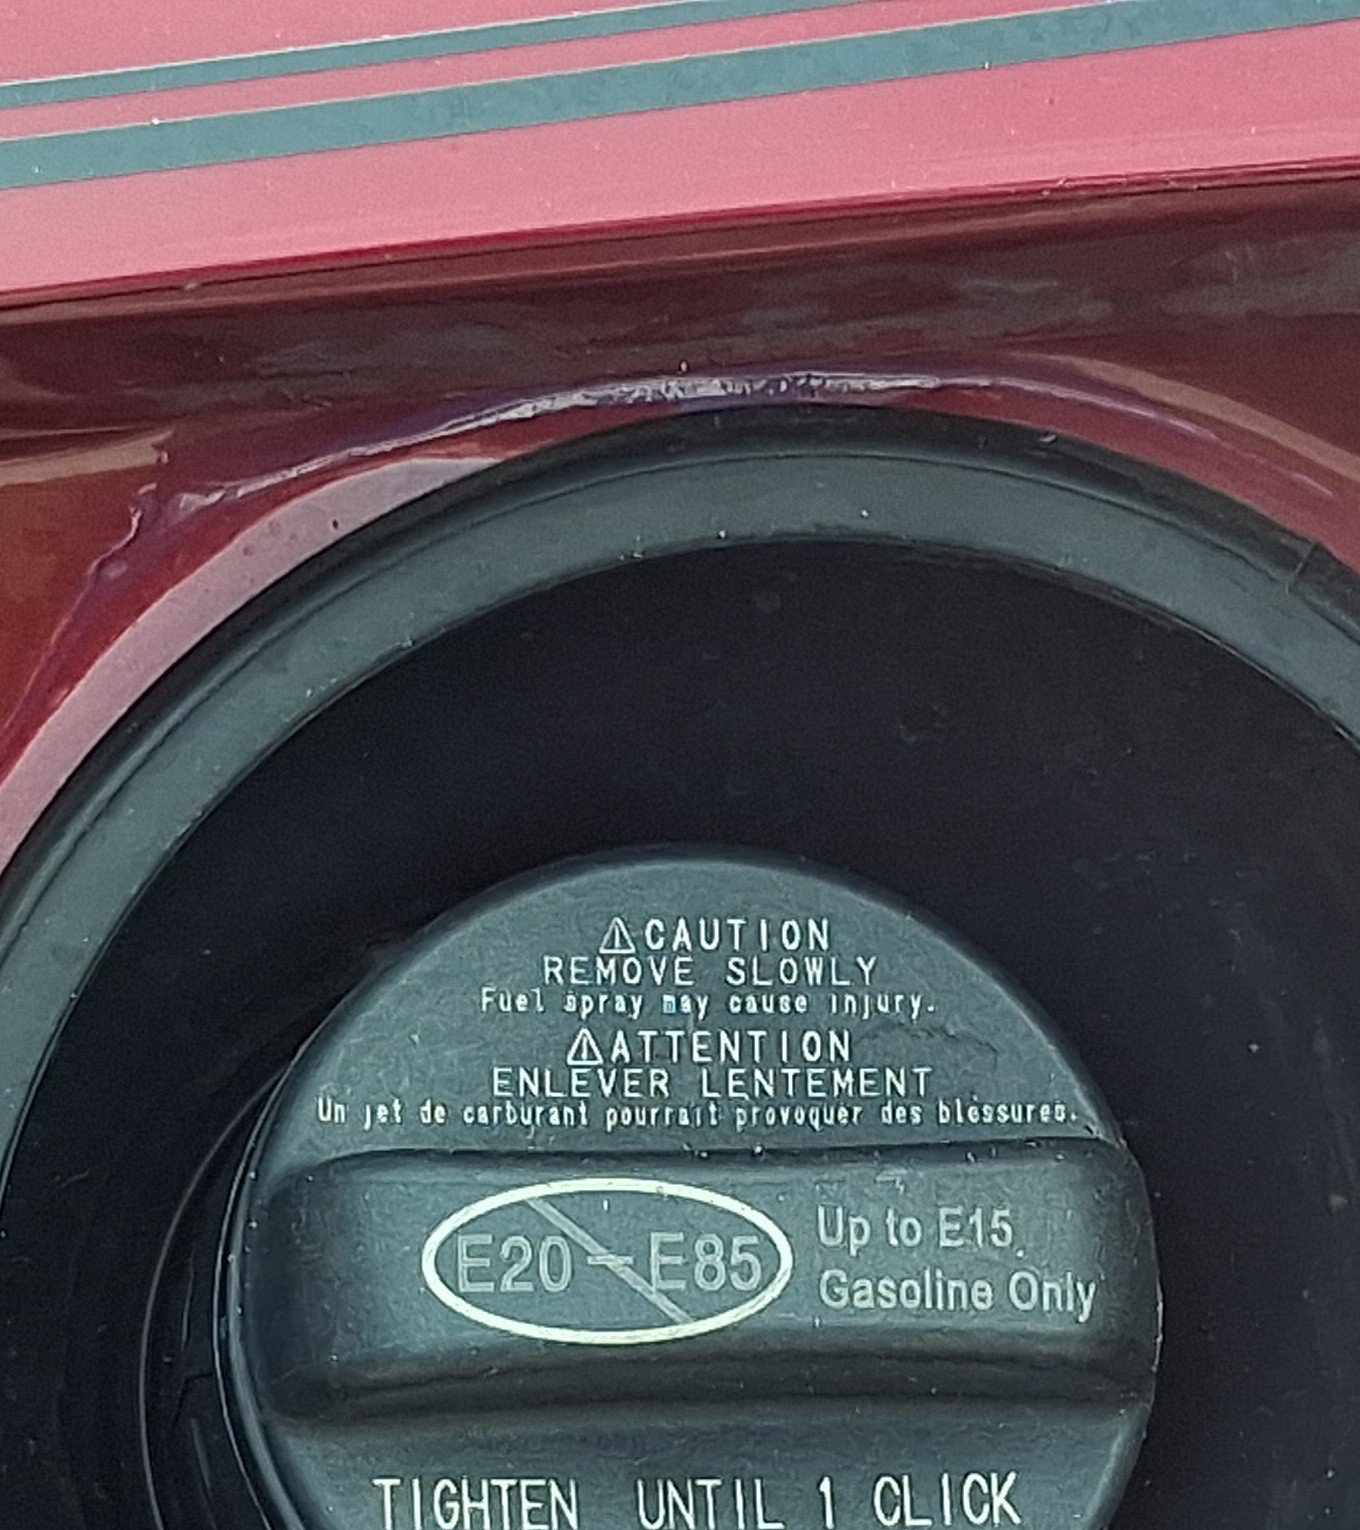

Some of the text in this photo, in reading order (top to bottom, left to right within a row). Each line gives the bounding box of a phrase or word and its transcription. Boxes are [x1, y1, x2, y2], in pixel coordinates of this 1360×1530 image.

[644, 917, 831, 952] CAUTION
[543, 956, 878, 986] REMOVE SLOWLY
[479, 987, 938, 1019] Fuel spray may cause injury.
[610, 1029, 852, 1064] ATTENTION
[492, 1067, 933, 1098] ENLEVER LENTEMENT
[316, 1098, 346, 1124] Un
[362, 1099, 403, 1130] jet
[419, 1099, 447, 1124] de
[462, 1099, 589, 1128] carburant
[604, 1099, 720, 1132] pourrait
[735, 1100, 864, 1132] provoquer
[880, 1099, 923, 1125] des
[816, 1206, 865, 1256] Up
[884, 1208, 921, 1250] to
[455, 1233, 573, 1294] E20
[649, 1231, 764, 1292] E85
[818, 1269, 1097, 1323] Gasoline Only
[637, 1476, 786, 1530] UNTIL
[818, 1475, 836, 1530] 1
[873, 1471, 1024, 1528] CLICK
